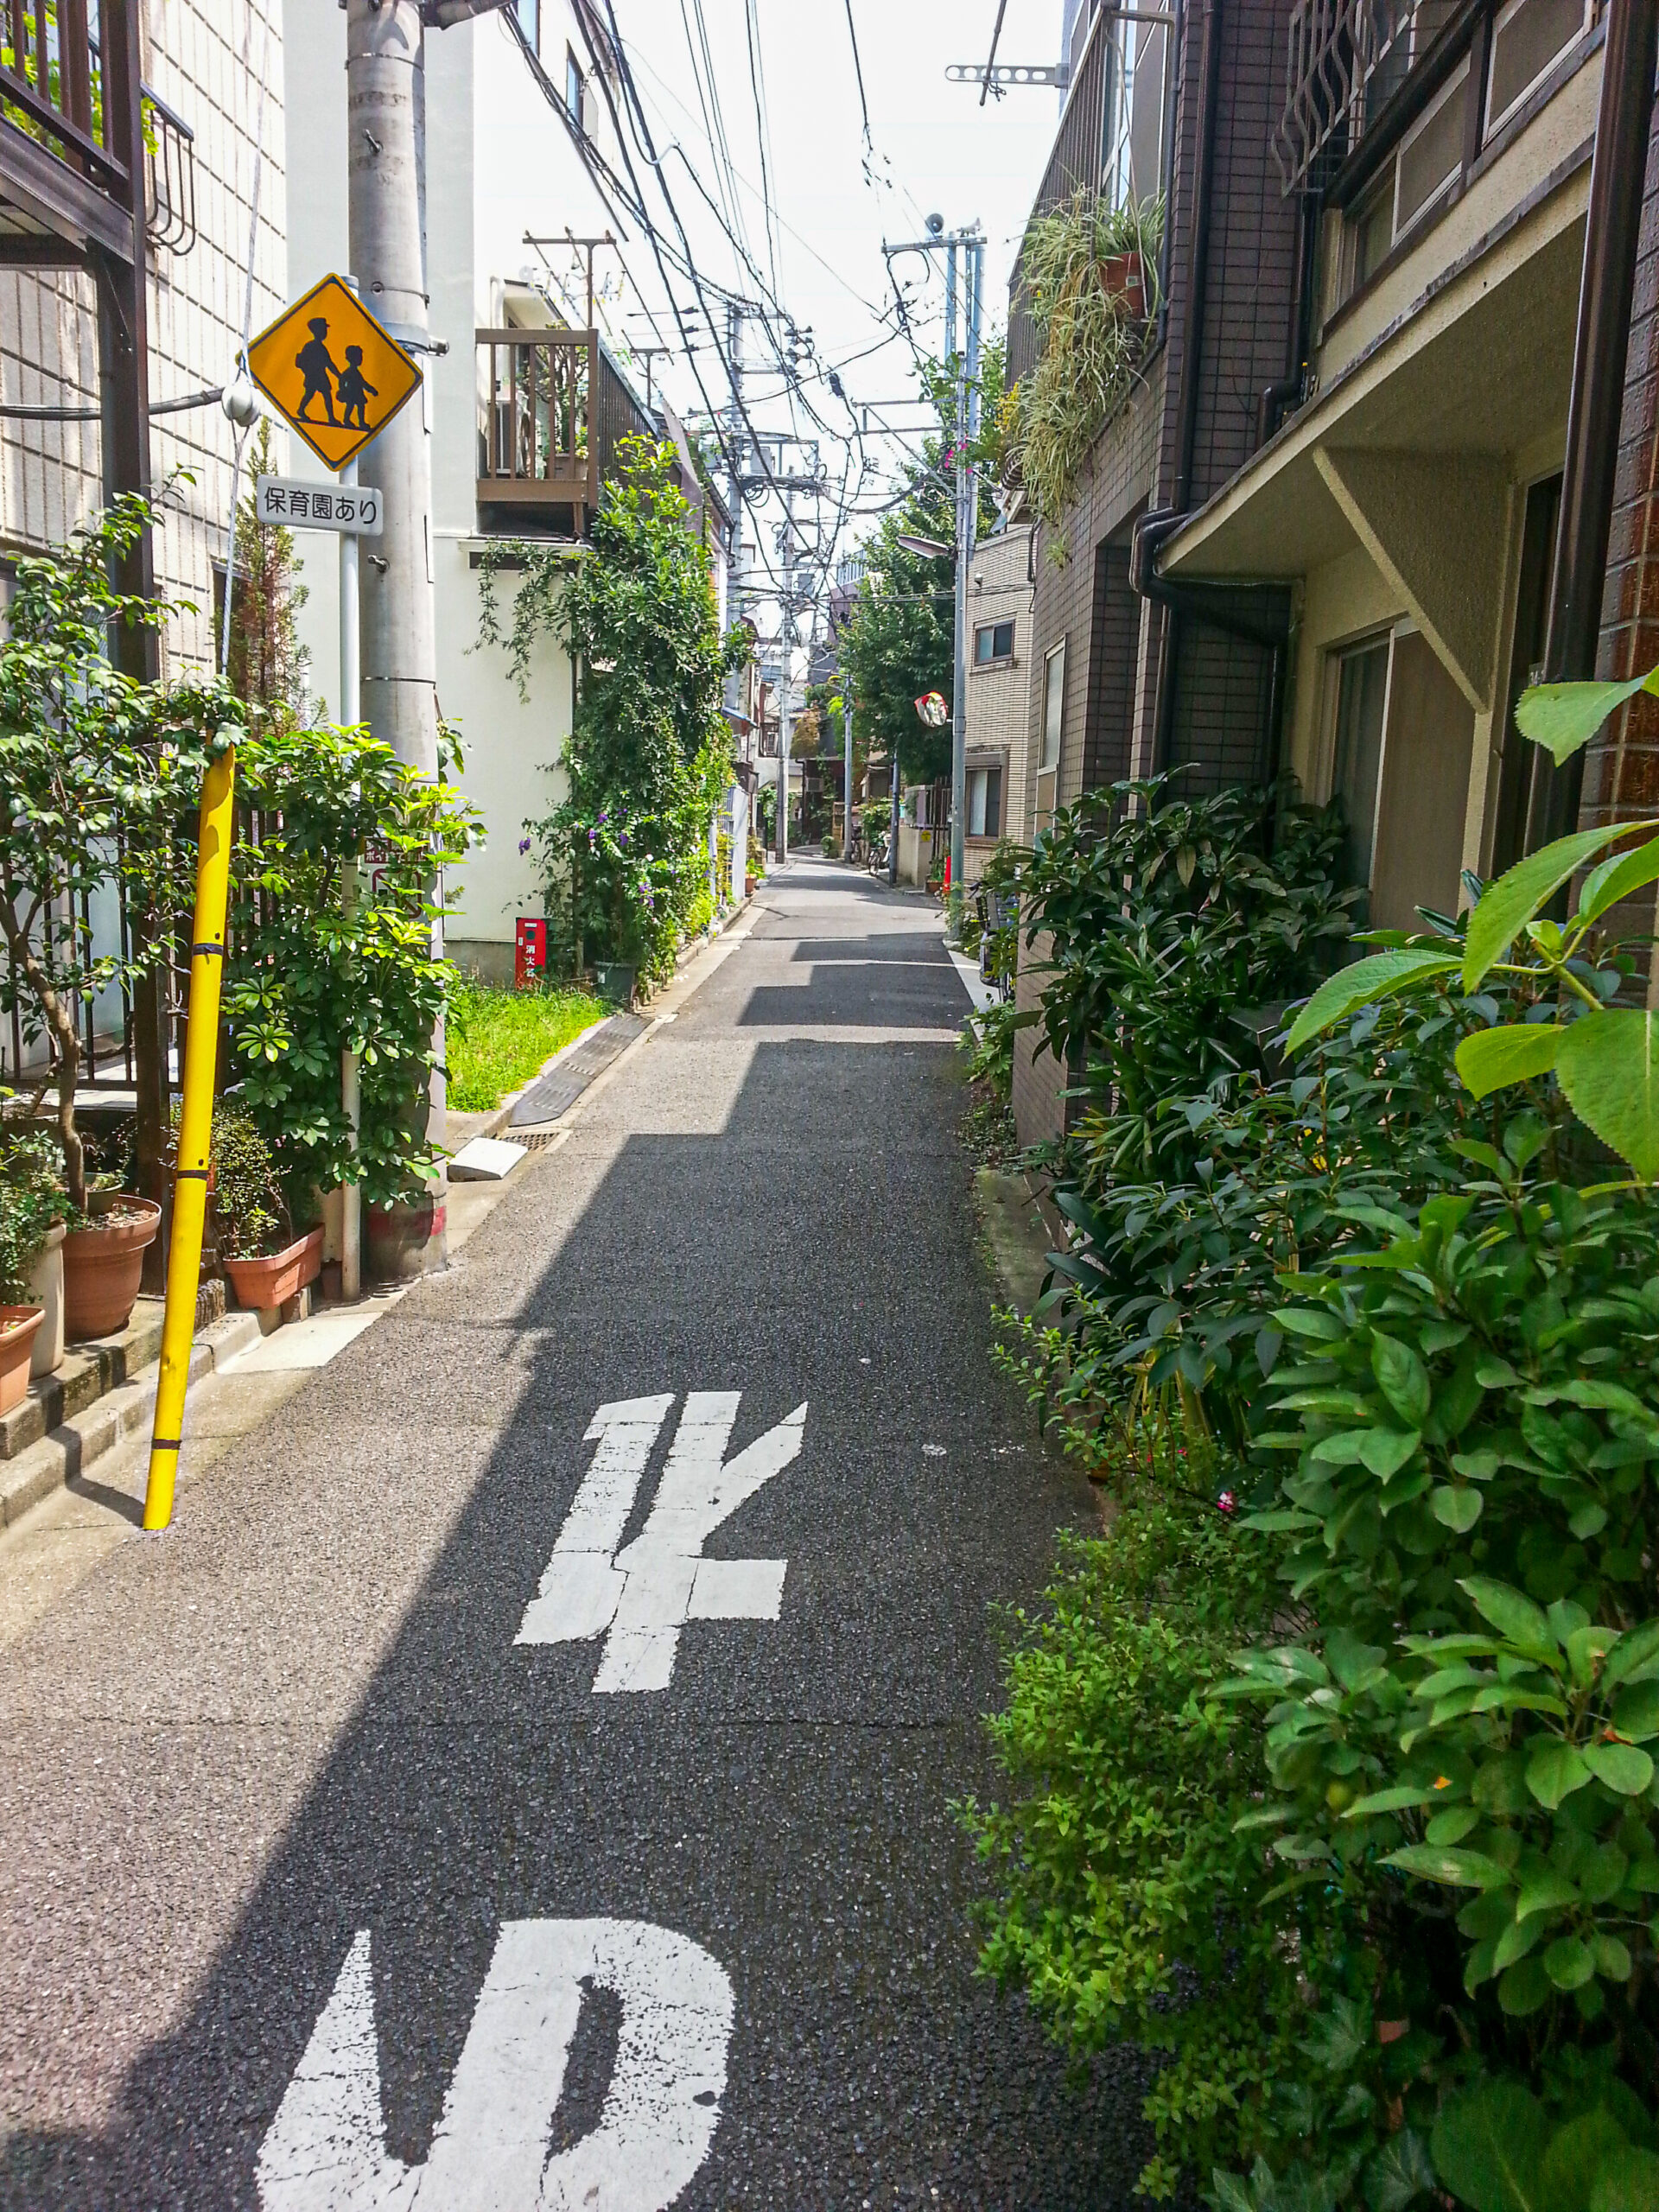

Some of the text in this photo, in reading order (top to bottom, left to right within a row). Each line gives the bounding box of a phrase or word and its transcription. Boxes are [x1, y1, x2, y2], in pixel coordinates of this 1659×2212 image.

[264, 486, 377, 524] 保育園あり
[366, 850, 427, 861] ポイて止
